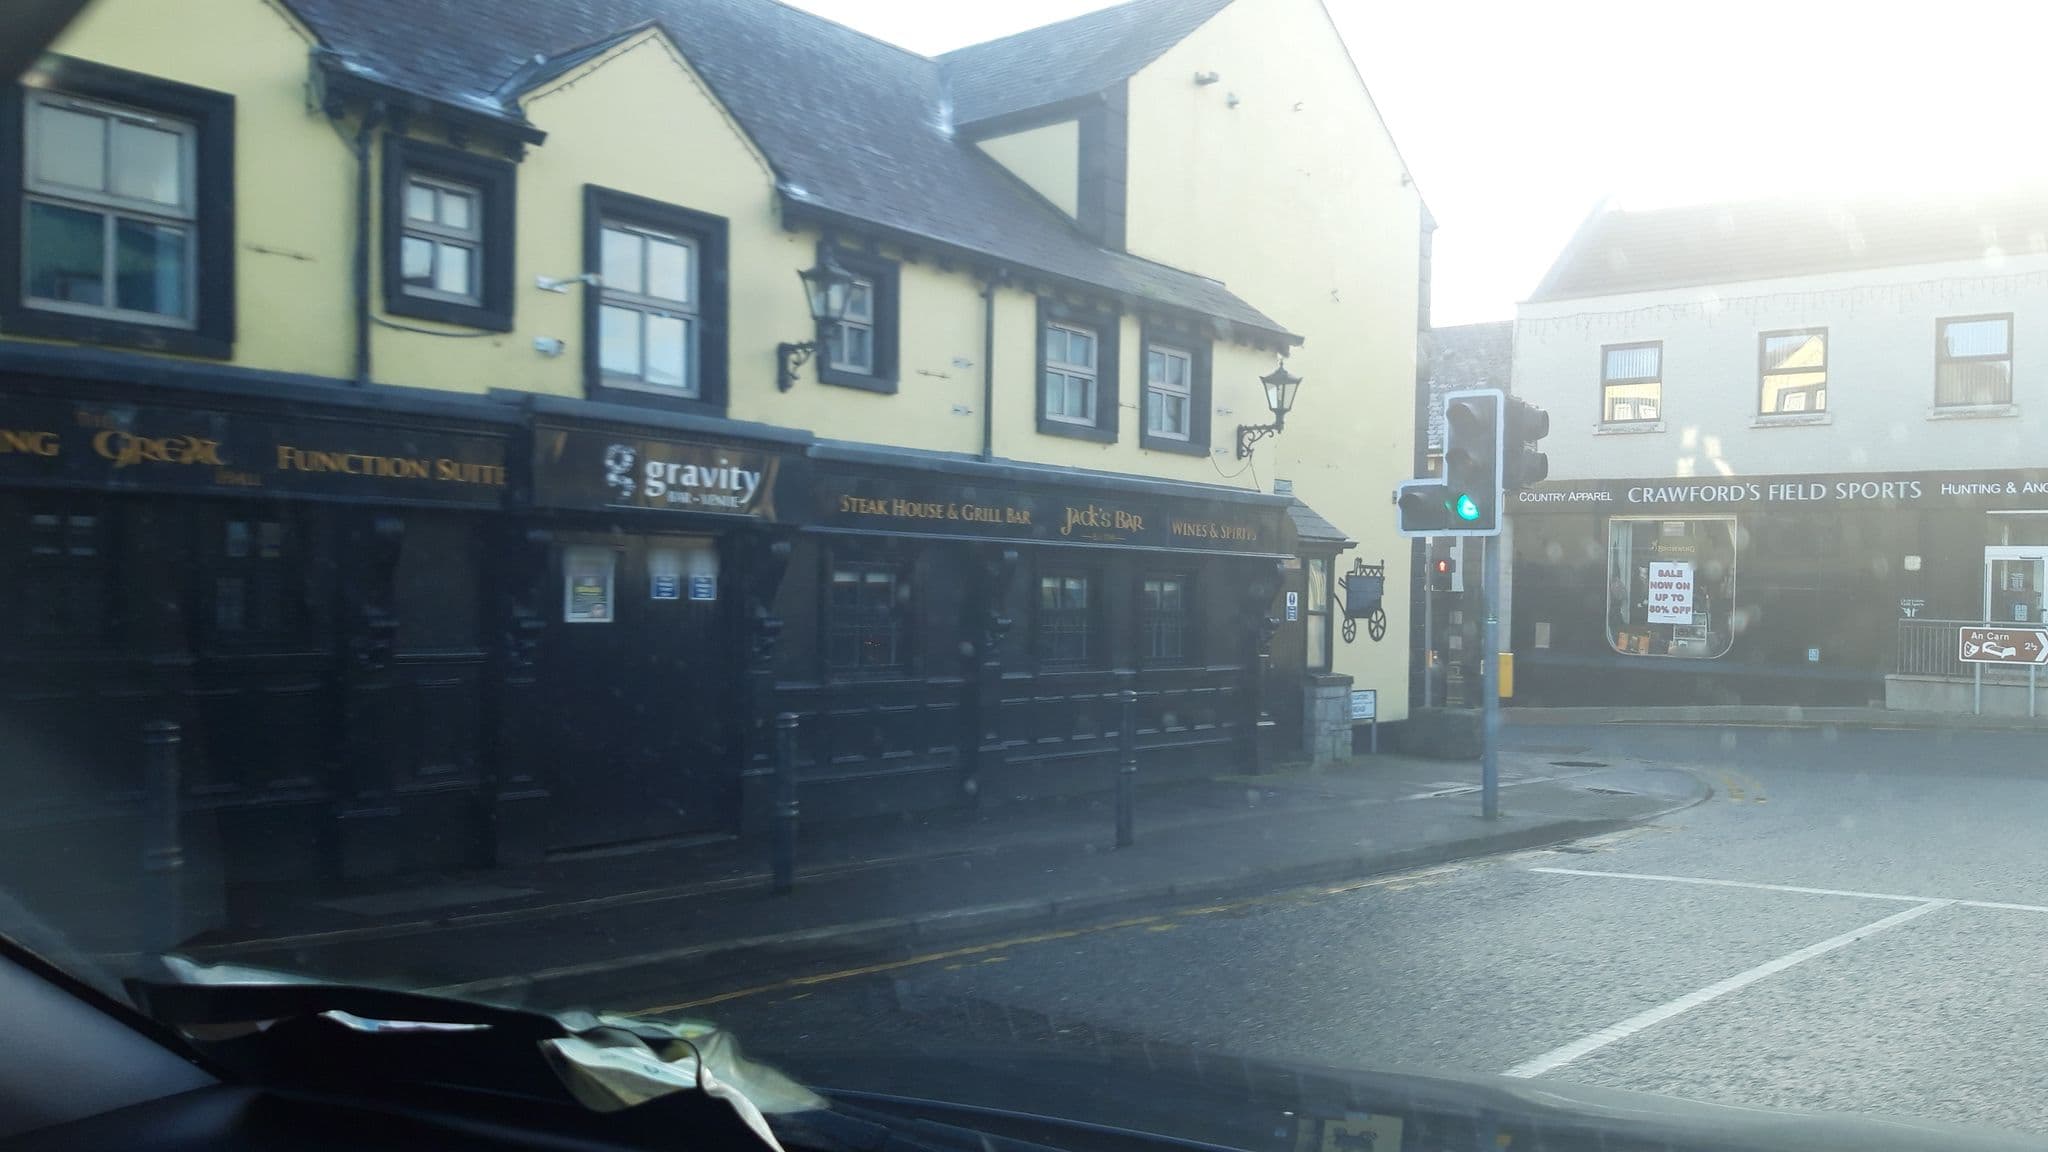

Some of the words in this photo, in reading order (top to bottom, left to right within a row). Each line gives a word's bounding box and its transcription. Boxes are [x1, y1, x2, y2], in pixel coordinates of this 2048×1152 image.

[644, 458, 761, 504] gravity
[1628, 483, 1761, 503] CRAWFORD'S
[1768, 484, 1827, 501] FIELD
[1836, 481, 1922, 499] SPORTS
[1941, 483, 2001, 495] HUNTING
[2006, 482, 2017, 494] &
[1519, 492, 1566, 502] COUNTRY
[1568, 490, 1613, 502] APPAREL
[840, 495, 888, 515] STEAK
[893, 499, 944, 519] HOUSE
[946, 503, 959, 520] &
[962, 504, 1003, 523] GRILL
[1006, 508, 1032, 525] BAR
[1172, 519, 1207, 538] WINES
[1209, 522, 1219, 538] &
[1650, 582, 1673, 590] NOW
[1676, 582, 1690, 590] ON
[1671, 594, 1684, 602] TO
[1672, 606, 1691, 614] OFF
[1970, 631, 1984, 640] An
[1986, 631, 2010, 641] Carn
